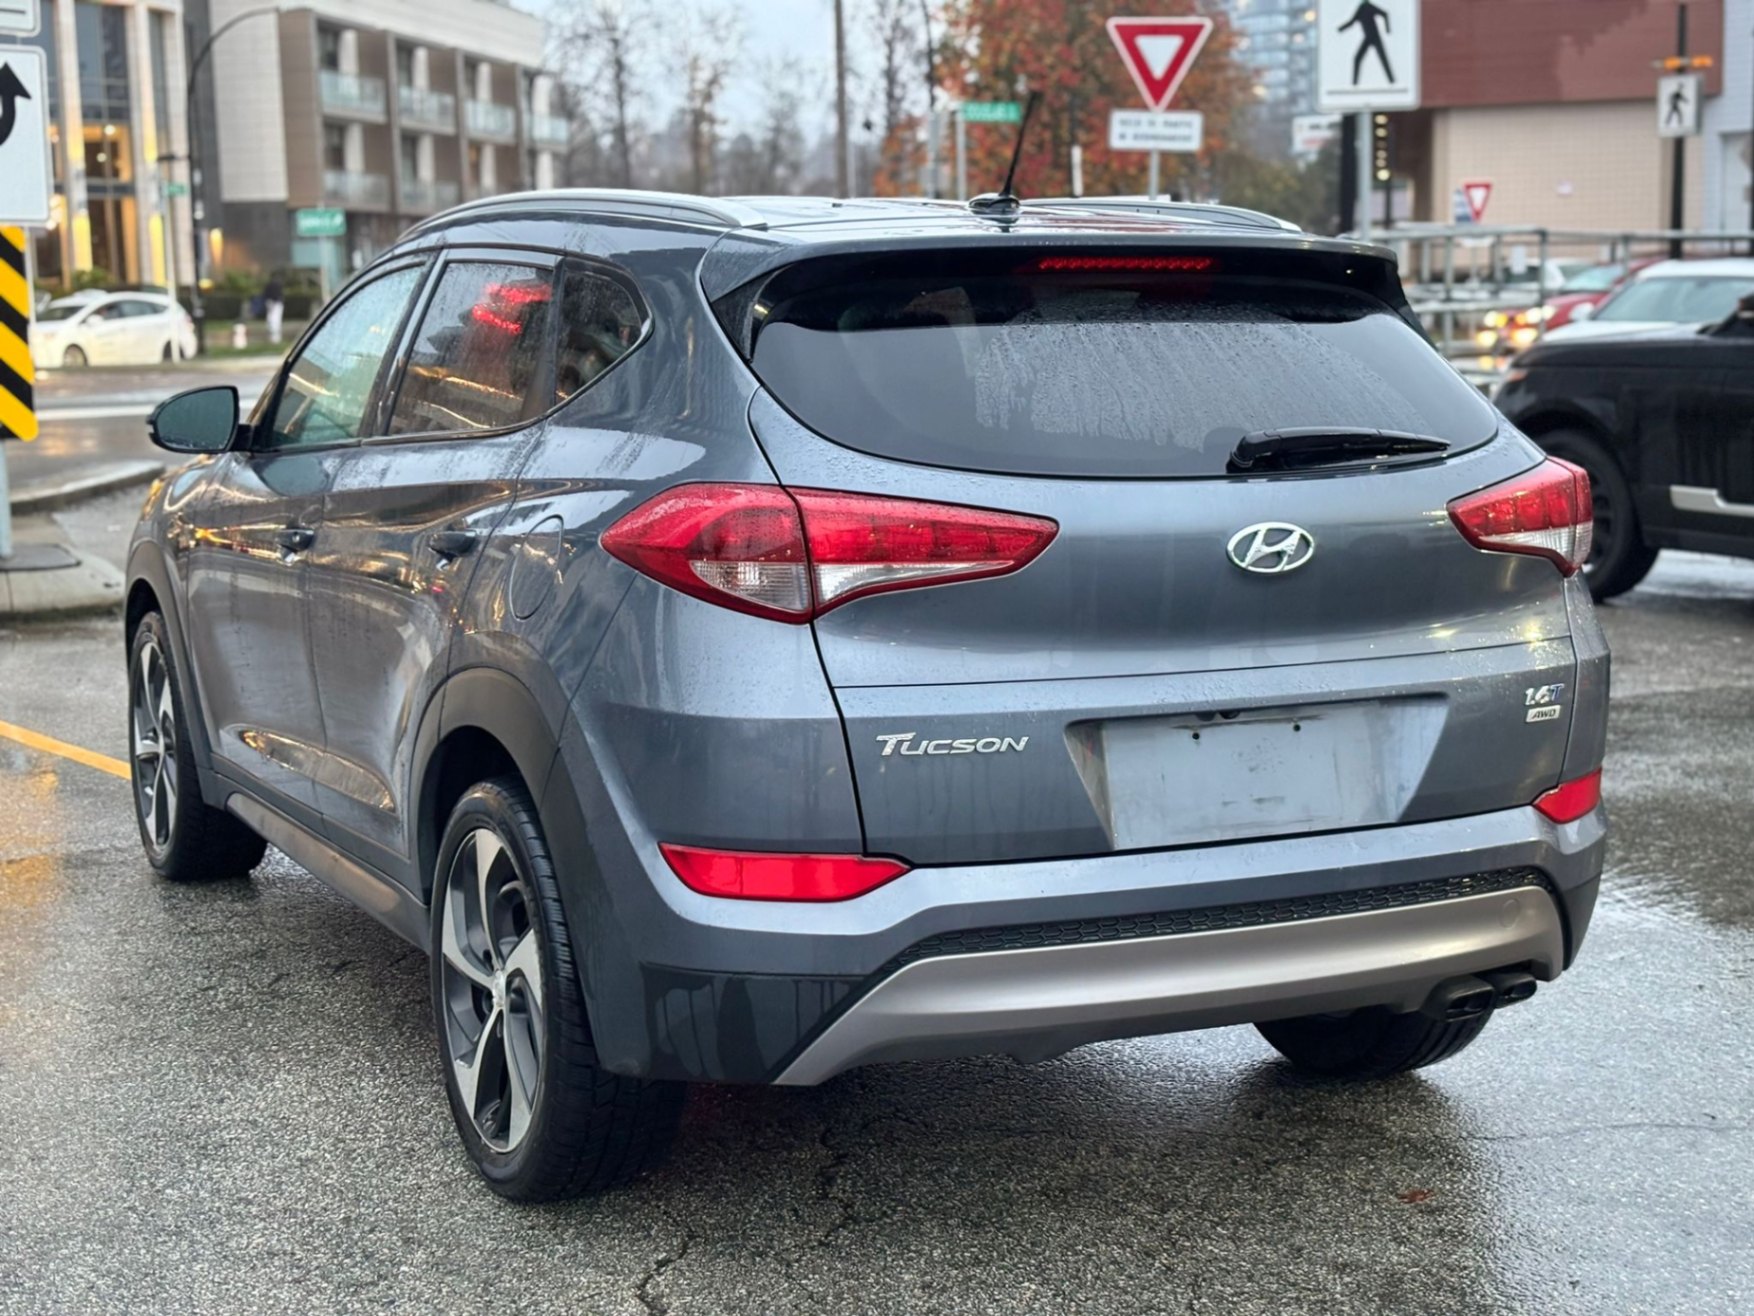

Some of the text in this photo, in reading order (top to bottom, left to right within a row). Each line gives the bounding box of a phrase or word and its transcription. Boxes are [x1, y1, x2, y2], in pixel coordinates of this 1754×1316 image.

[1525, 683, 1565, 705] 1.6T
[1531, 708, 1557, 720] AWD
[876, 732, 1029, 756] TUCSON
